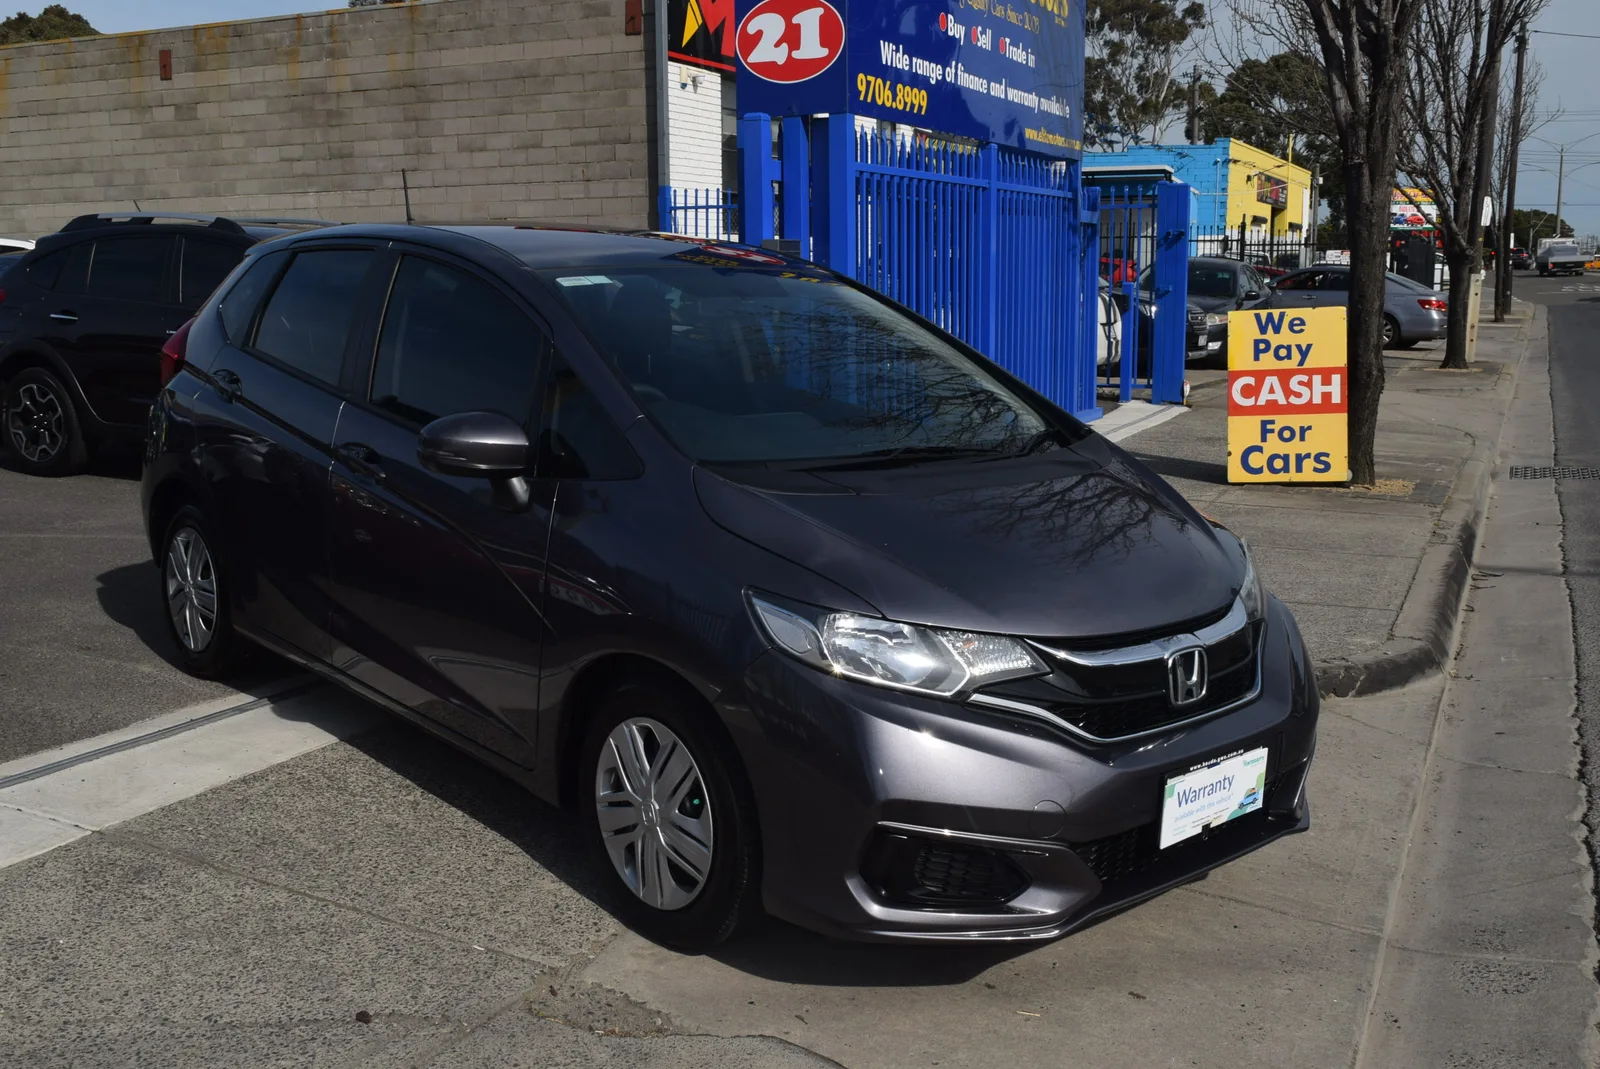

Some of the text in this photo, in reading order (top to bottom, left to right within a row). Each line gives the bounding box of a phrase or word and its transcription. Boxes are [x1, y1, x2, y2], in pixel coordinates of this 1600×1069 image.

[746, 7, 829, 65] 21
[947, 14, 1036, 68] Buy Sell Trade in
[880, 40, 910, 71] Wide
[912, 56, 943, 85] range
[945, 61, 956, 83] of
[957, 62, 988, 93] finance
[990, 78, 1006, 99] and
[1007, 86, 1039, 113] warranty
[857, 73, 928, 115] 9706.8999
[1254, 311, 1307, 335] We
[1253, 338, 1313, 367] Pay
[1231, 374, 1341, 407] CASH
[1260, 419, 1313, 443] For
[1240, 445, 1332, 475] Cars
[1177, 774, 1235, 809] Warranty
